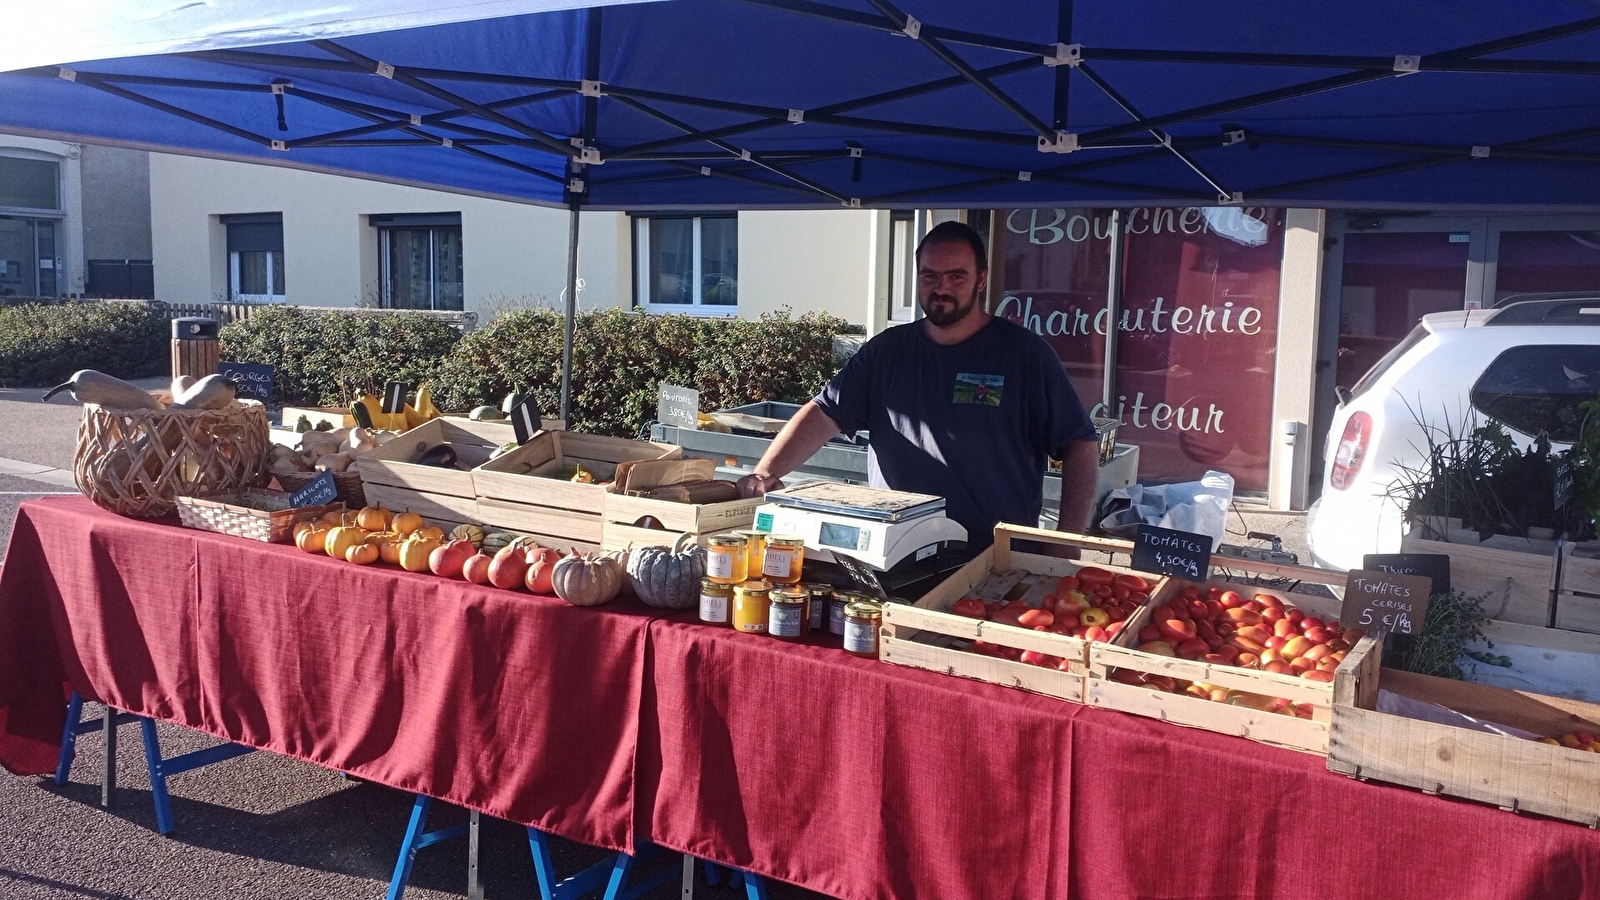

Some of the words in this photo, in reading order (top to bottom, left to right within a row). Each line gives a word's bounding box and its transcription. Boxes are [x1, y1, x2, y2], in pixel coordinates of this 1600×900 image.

[995, 296, 1262, 336] Charcuterie
[293, 477, 328, 505] HARICOTS
[1141, 532, 1202, 553] TOMATES
[1354, 578, 1411, 598] TOMATES
[1371, 599, 1413, 612] CERISES
[1358, 608, 1374, 625] 5
